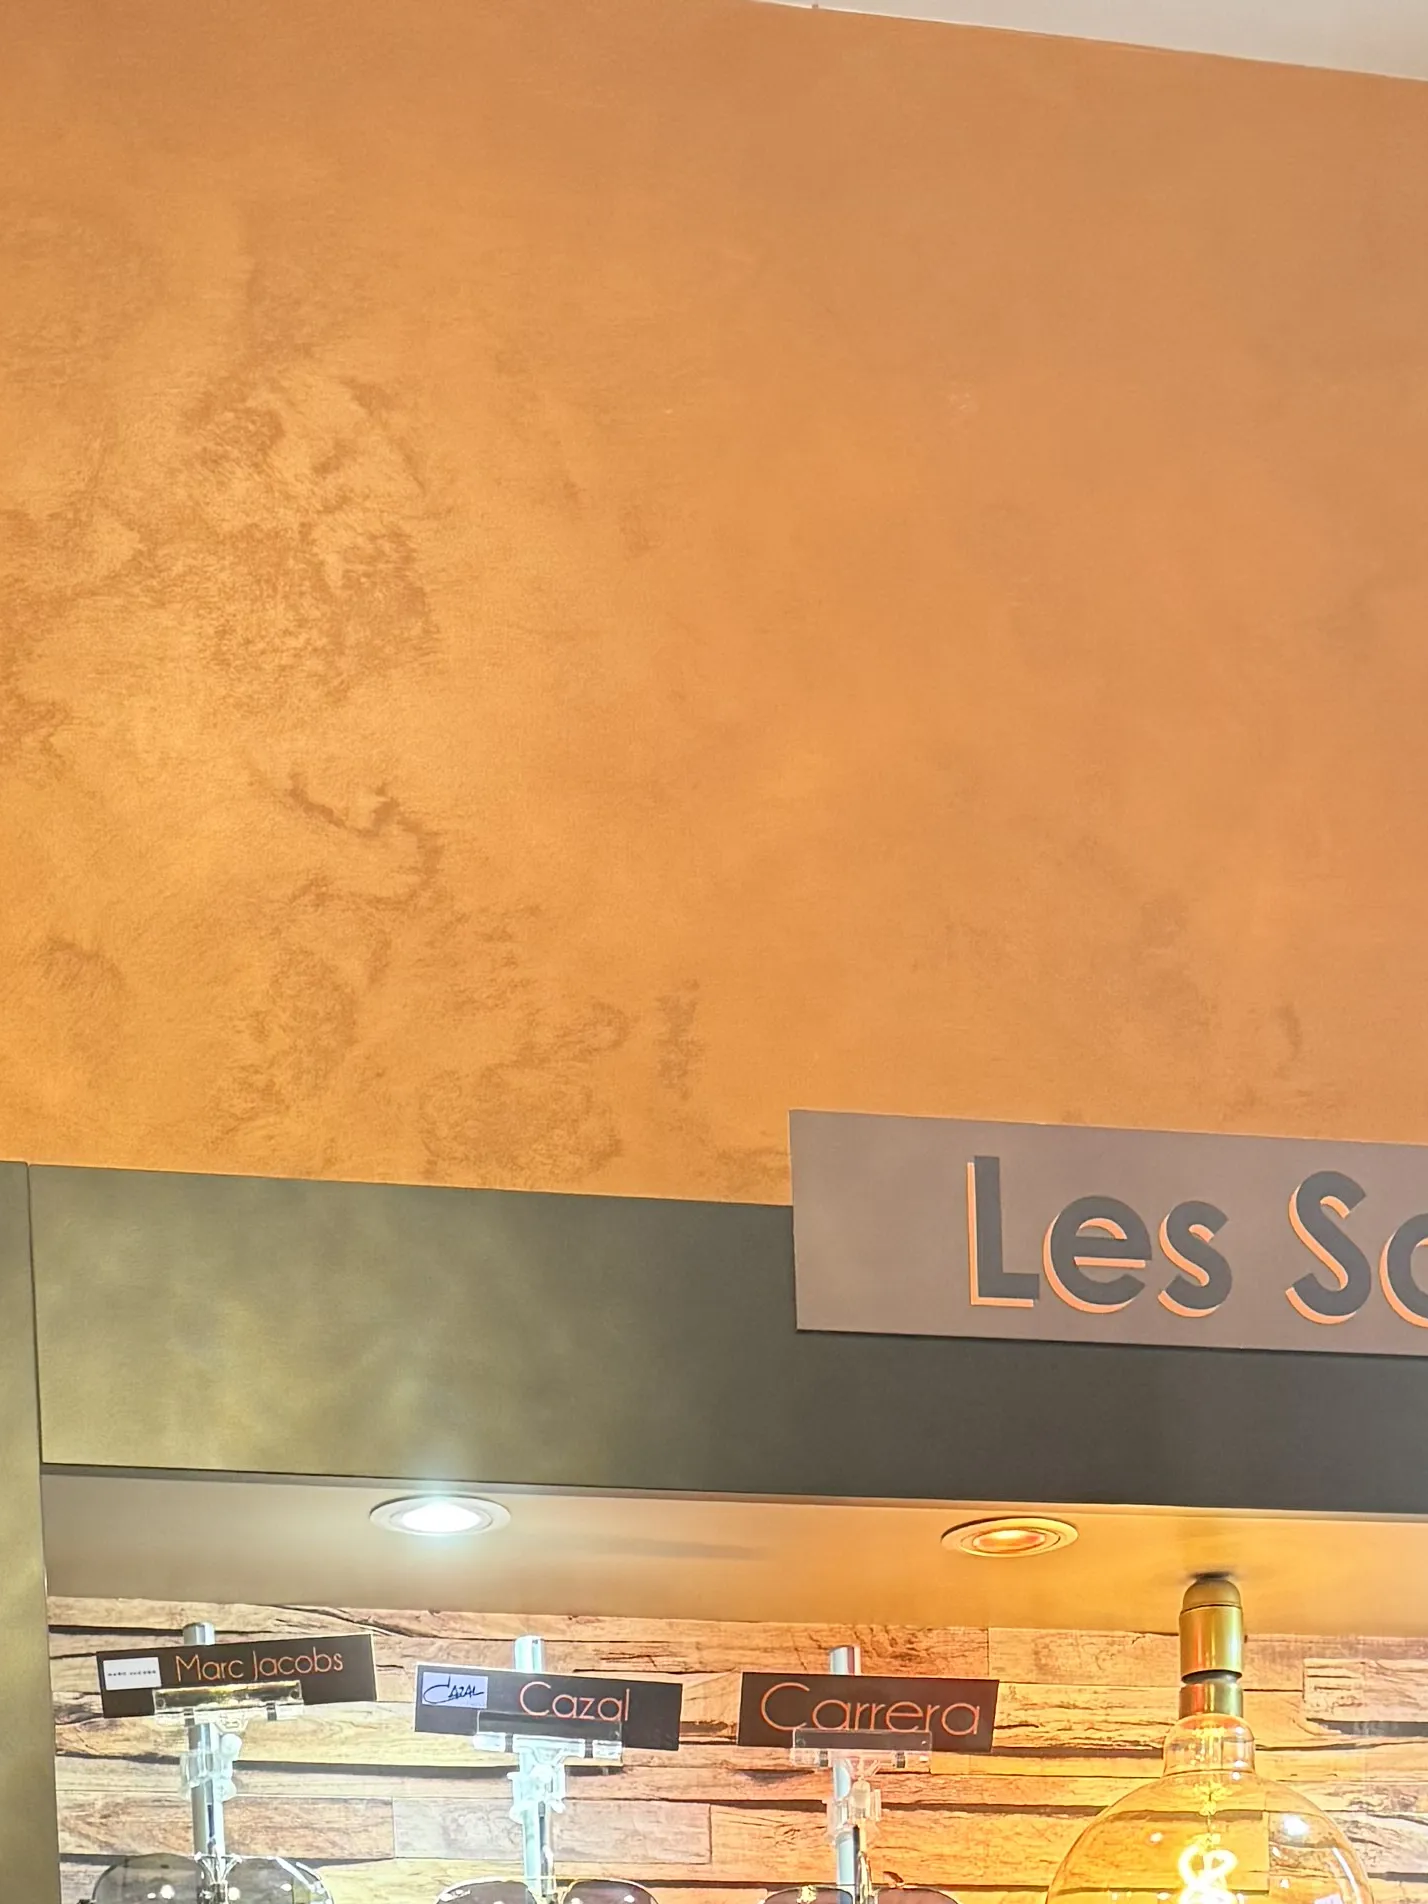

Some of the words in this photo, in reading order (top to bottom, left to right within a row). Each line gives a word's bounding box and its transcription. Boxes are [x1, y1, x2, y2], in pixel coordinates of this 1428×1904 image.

[967, 1154, 1230, 1318] Les
[175, 1653, 244, 1682] Marc
[252, 1645, 344, 1681] Jacobs
[519, 1680, 631, 1722] Cazal
[760, 1681, 981, 1737] Carrera
